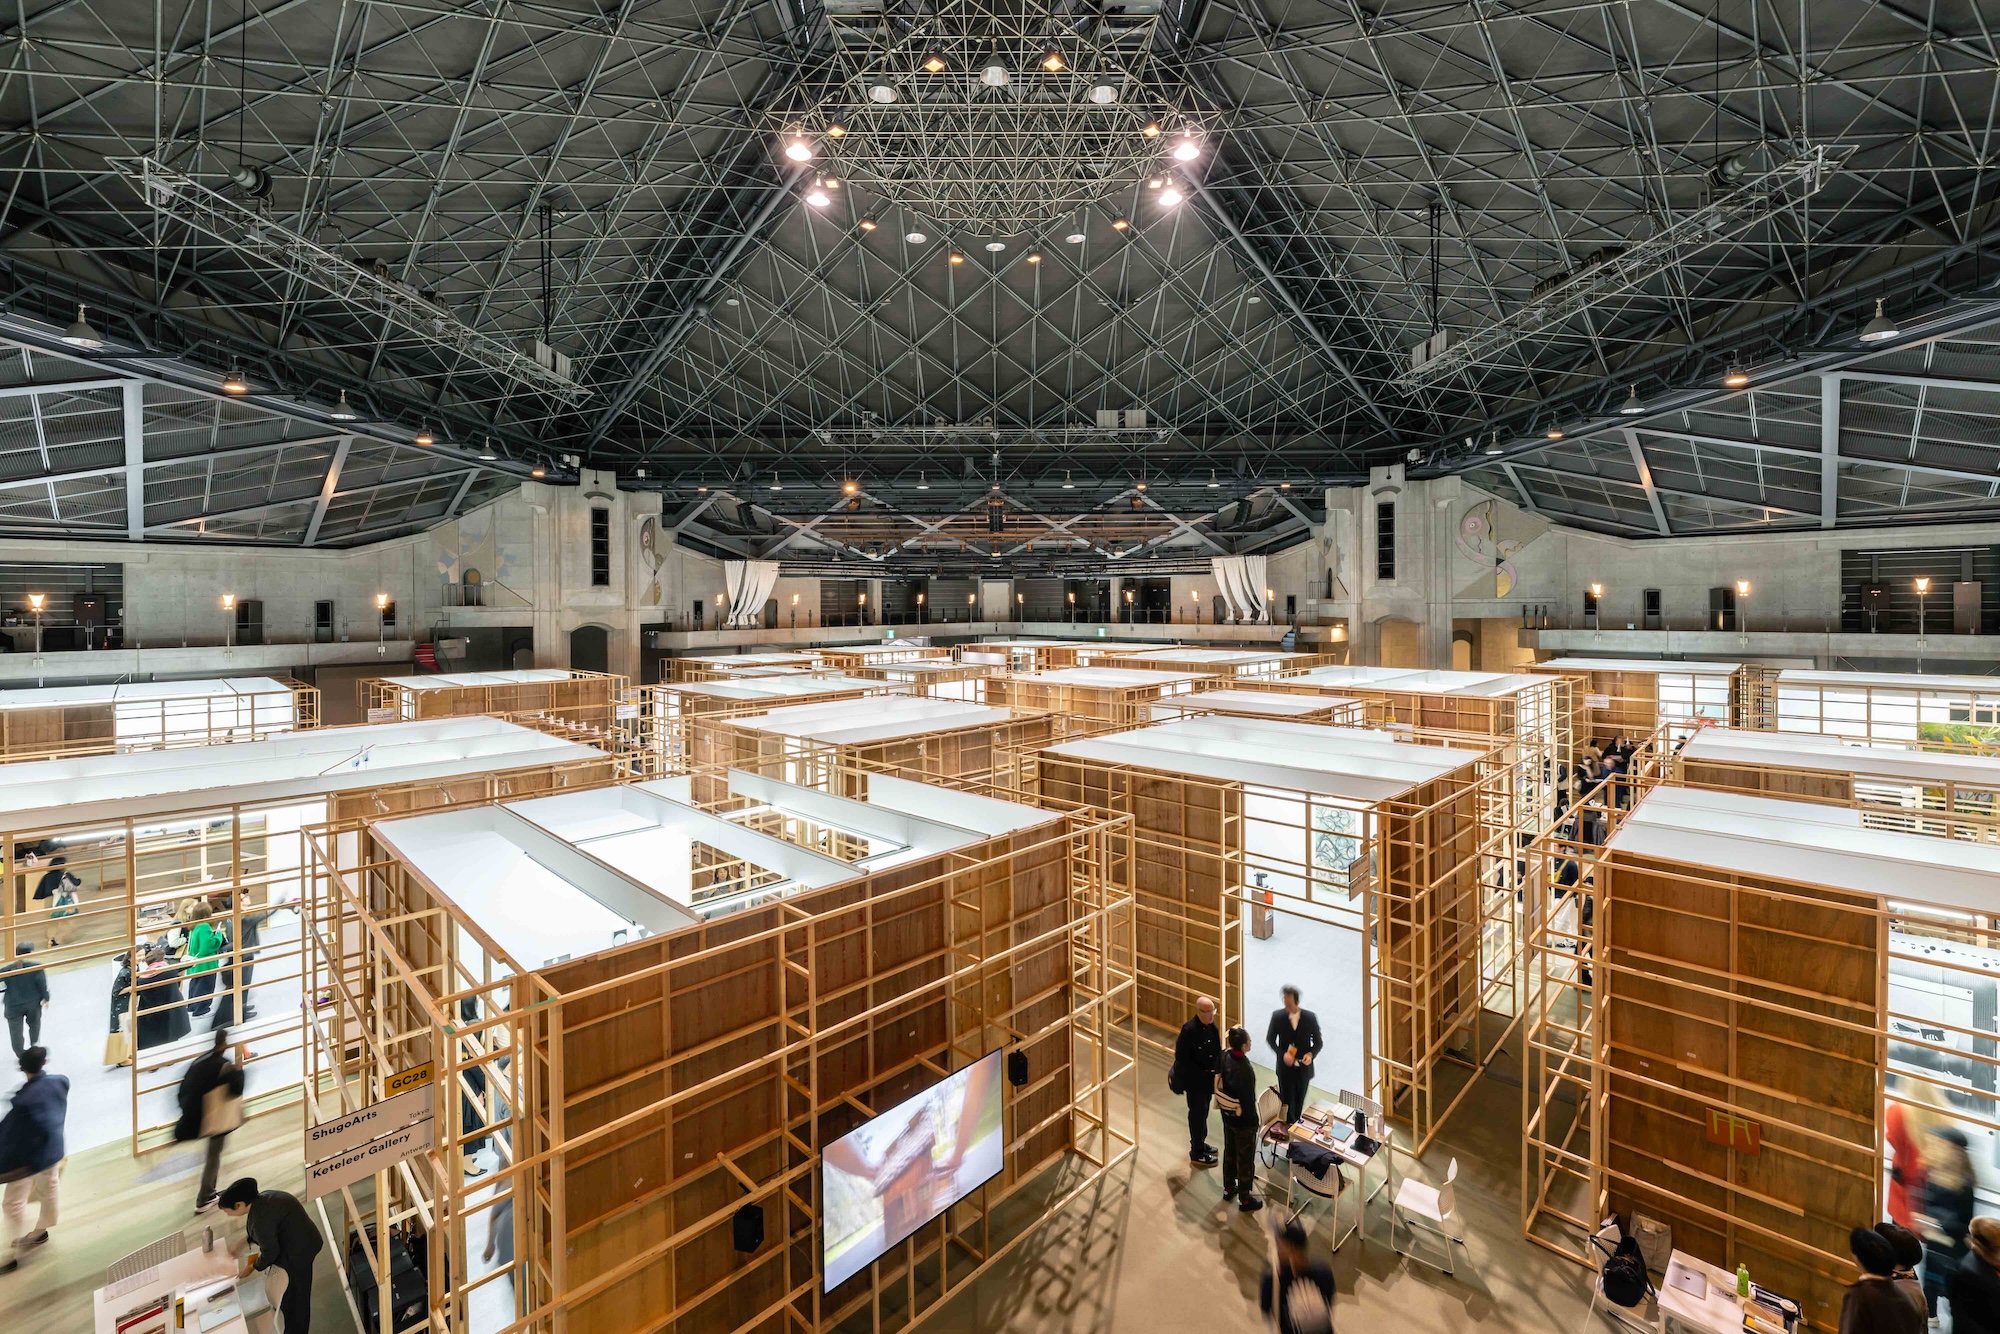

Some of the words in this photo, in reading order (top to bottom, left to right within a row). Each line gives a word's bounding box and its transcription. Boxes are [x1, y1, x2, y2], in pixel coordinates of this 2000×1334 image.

[392, 1070, 427, 1089] GC28
[409, 1108, 430, 1119] Tokyo
[312, 1111, 377, 1141] ShugoArts
[313, 1152, 365, 1179] Keteleer
[369, 1133, 411, 1155] Gallery
[400, 1142, 430, 1159] Antwerp
